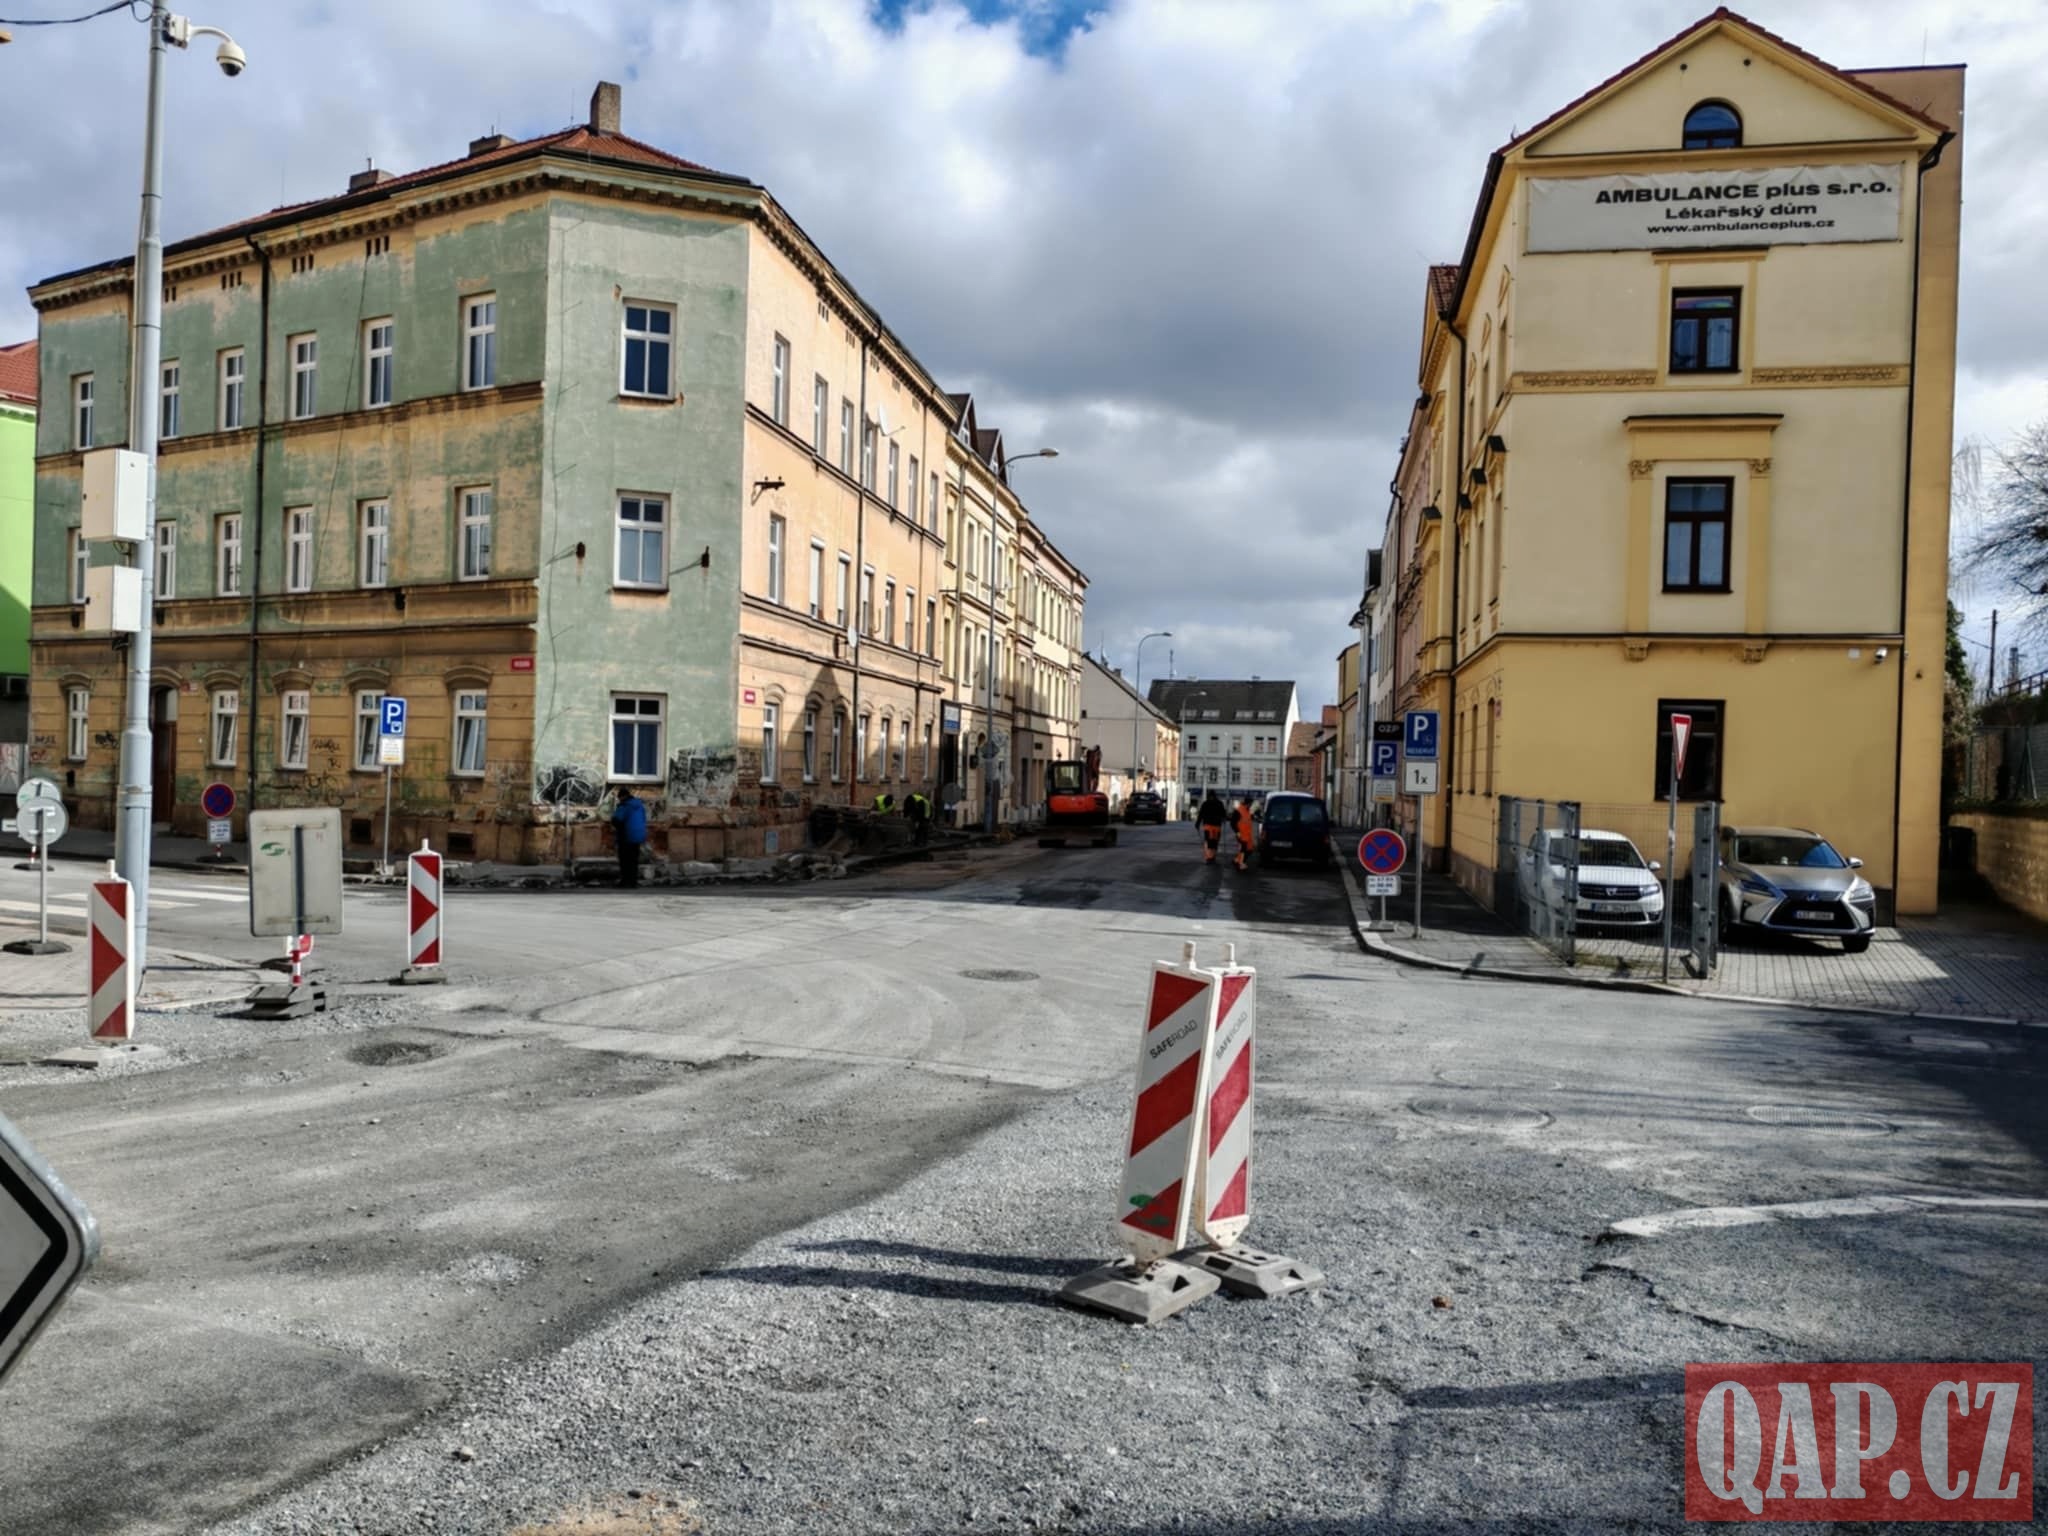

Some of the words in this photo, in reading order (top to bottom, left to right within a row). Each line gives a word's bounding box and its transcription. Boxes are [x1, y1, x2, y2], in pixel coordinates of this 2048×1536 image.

[1595, 183, 1759, 204] AMBULANCE
[1766, 183, 1820, 200] plus
[1827, 181, 1892, 195] s.r.o.
[1665, 205, 1764, 219] Lékařský
[1770, 203, 1817, 216] dům
[1647, 220, 1835, 233] www.ambulanceplus.cz
[387, 703, 401, 724] P
[1413, 715, 1429, 741] P
[1377, 746, 1393, 767] P
[1414, 769, 1428, 784] 1x
[1149, 1019, 1198, 1059] SAFEROAD
